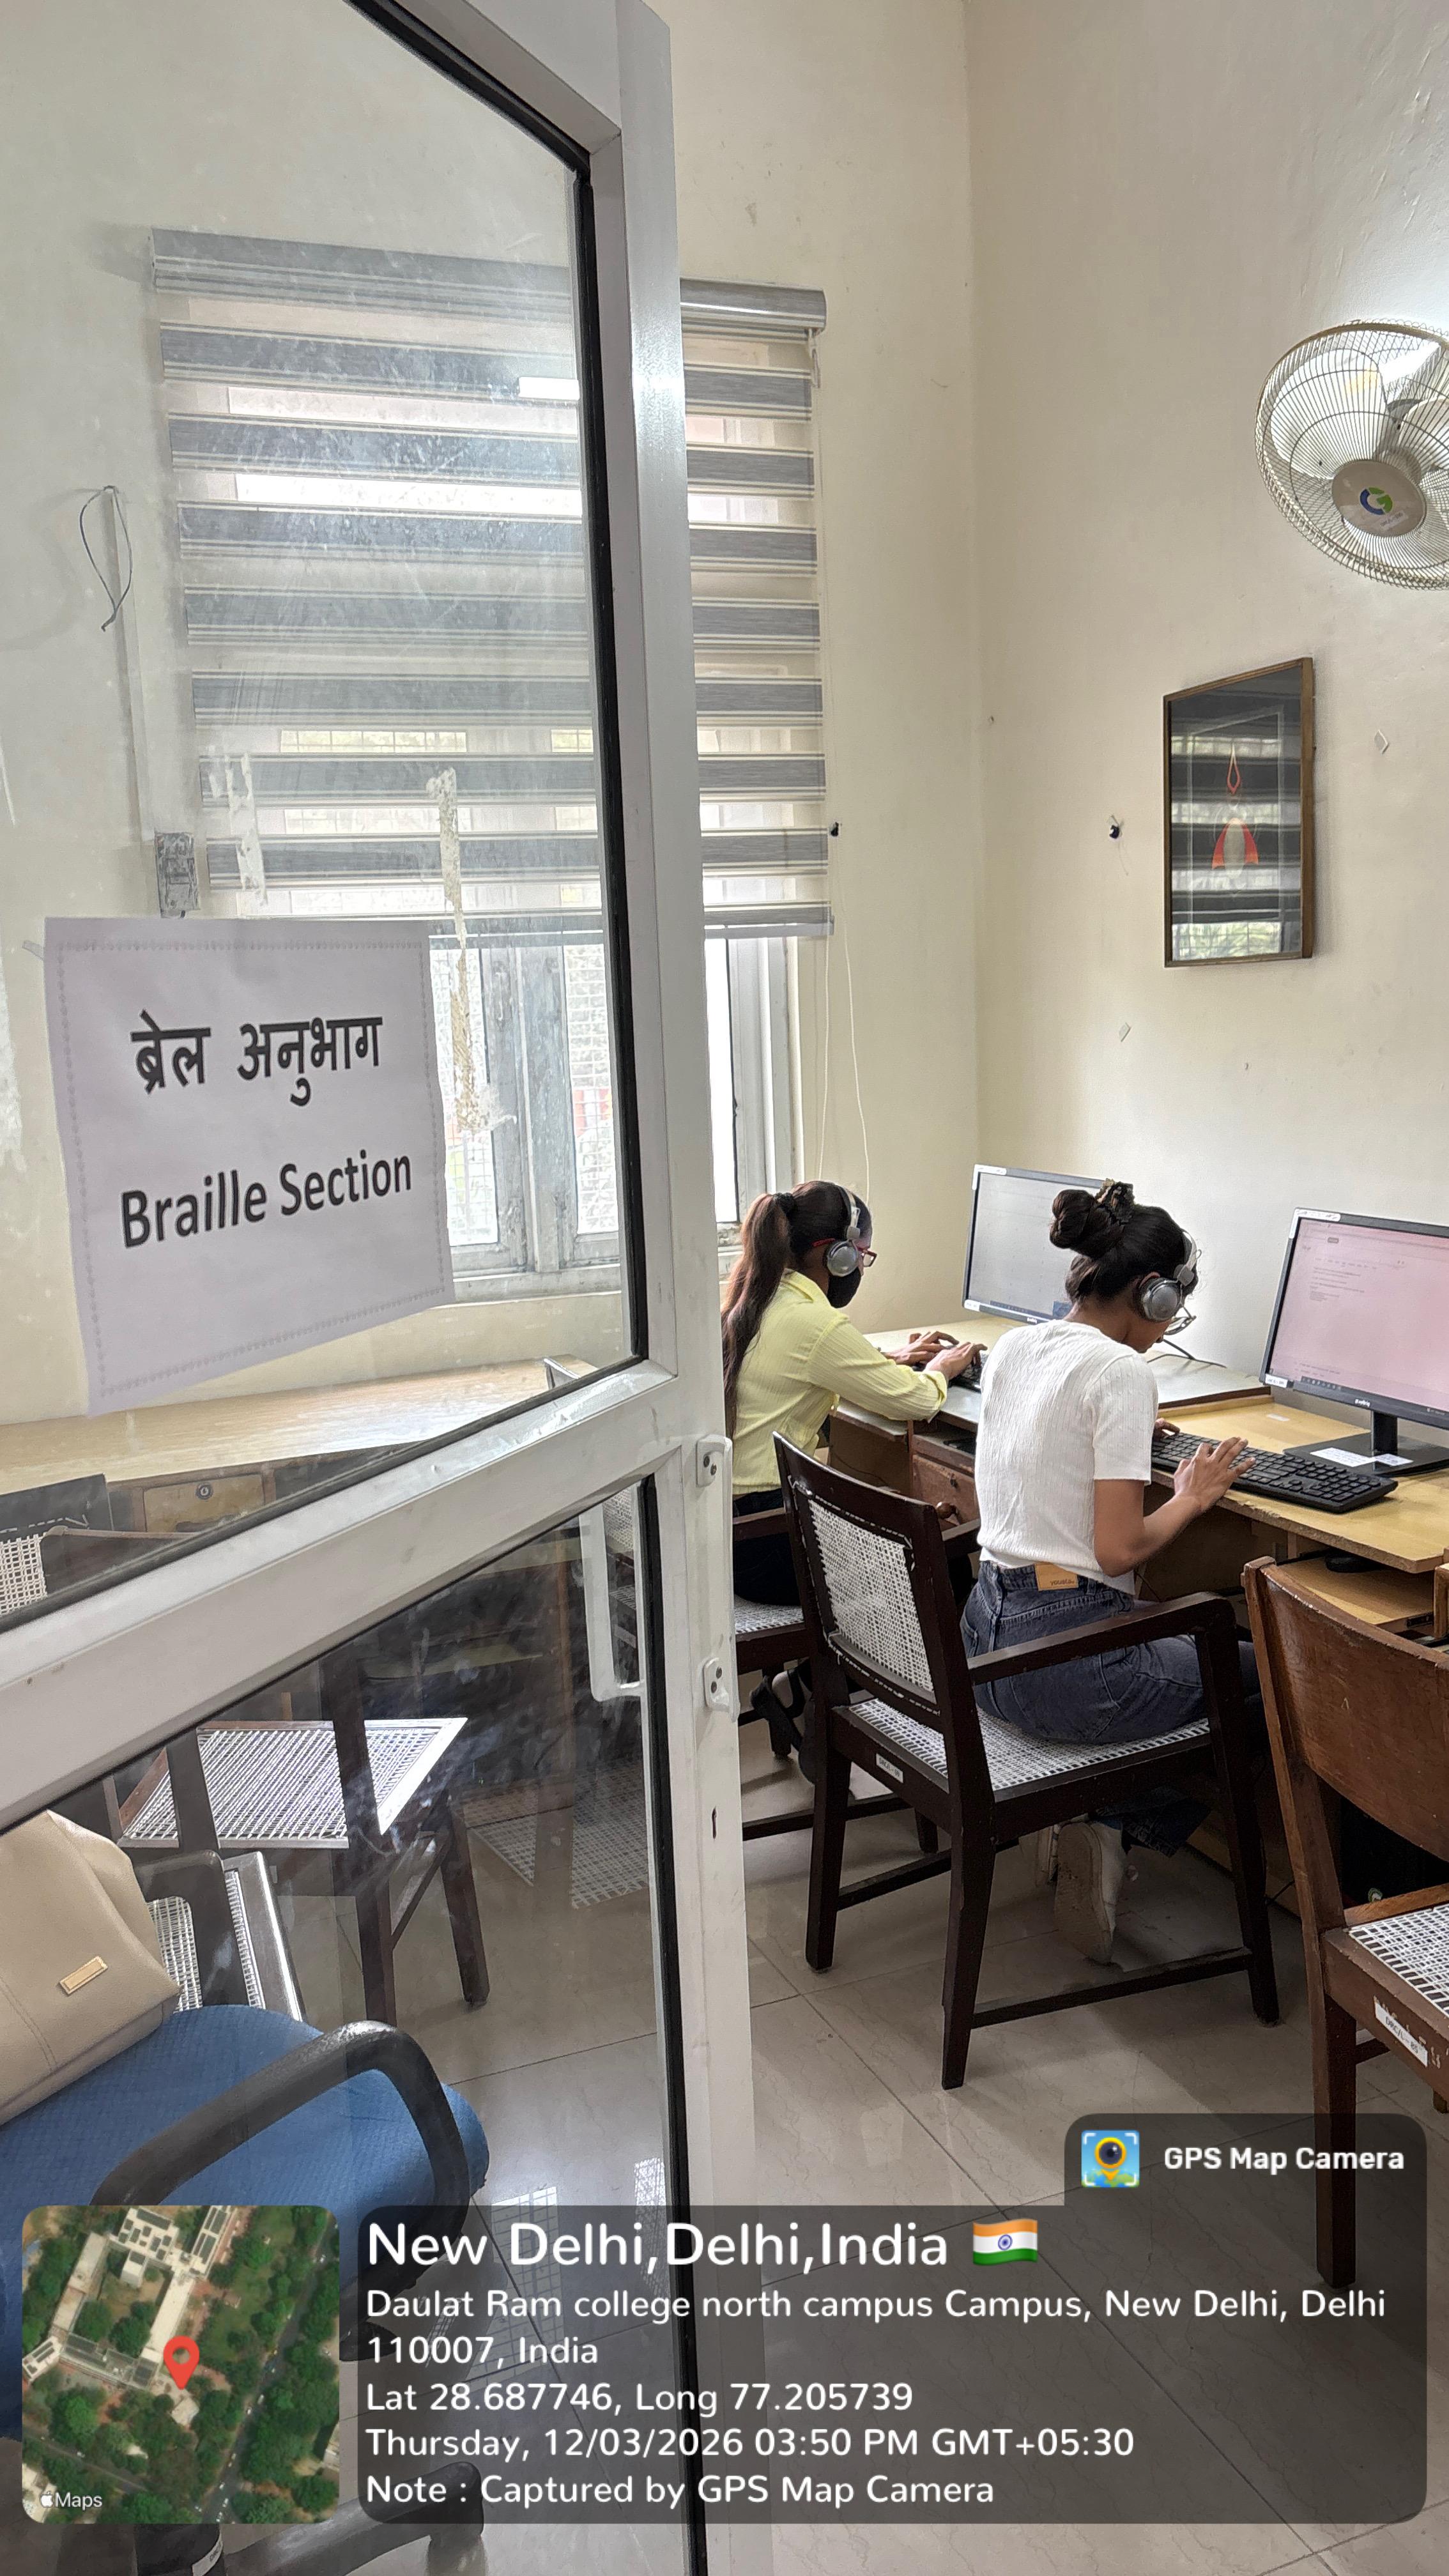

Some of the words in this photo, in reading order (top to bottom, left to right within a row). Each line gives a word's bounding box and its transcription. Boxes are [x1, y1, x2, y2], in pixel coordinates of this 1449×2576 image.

[130, 1009, 211, 1094] ब्रेल
[238, 1016, 383, 1107] अनुभाग
[122, 1170, 266, 1248] Braille
[280, 1149, 411, 1216] Section
